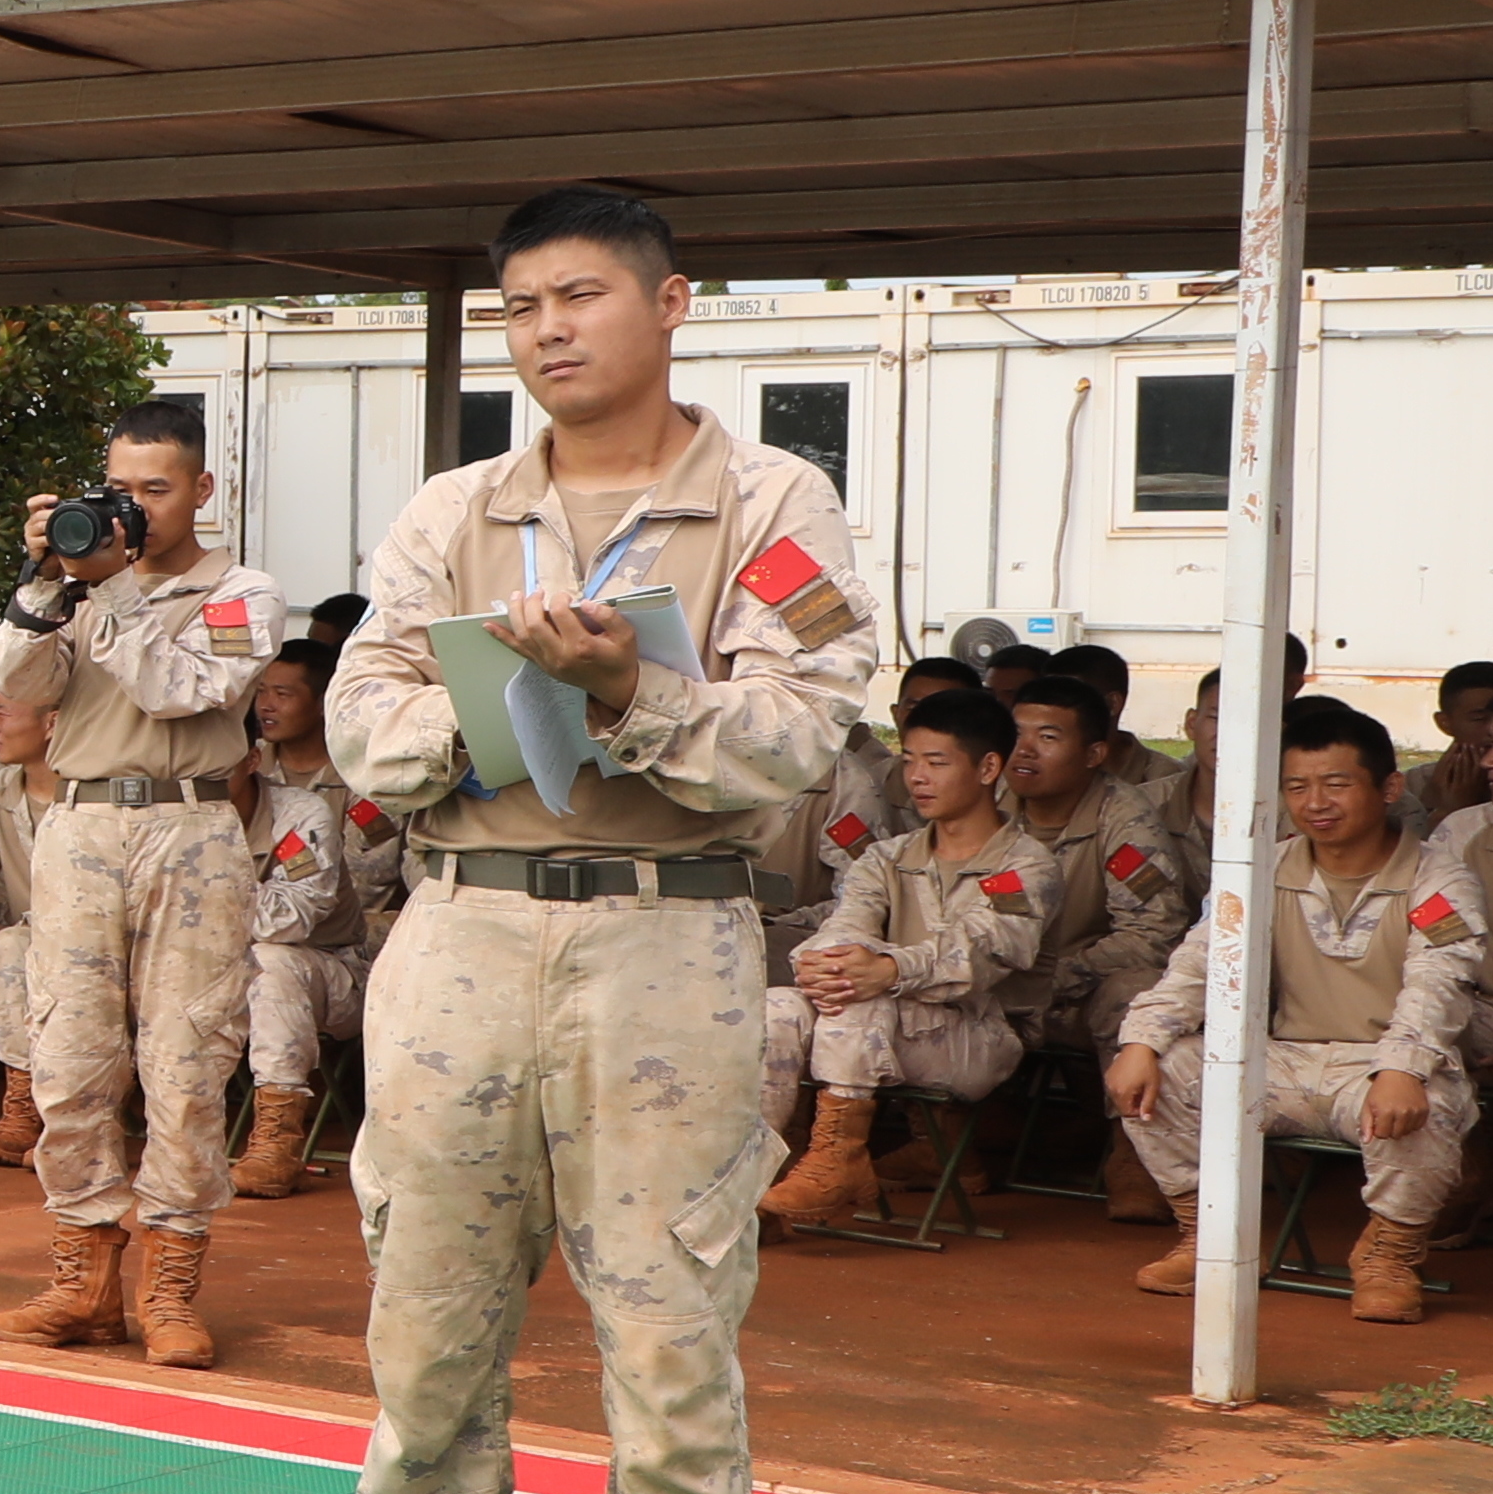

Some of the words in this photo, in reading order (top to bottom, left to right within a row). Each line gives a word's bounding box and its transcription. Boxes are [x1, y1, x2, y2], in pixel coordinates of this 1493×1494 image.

[1455, 273, 1493, 291] TLCU
[1040, 287, 1075, 304] TLCU
[1080, 285, 1131, 302] 170820
[1138, 283, 1149, 301] 5
[687, 301, 712, 318] LCU
[716, 299, 762, 316] 170852
[767, 298, 778, 315] 4
[356, 311, 384, 326] TLCU
